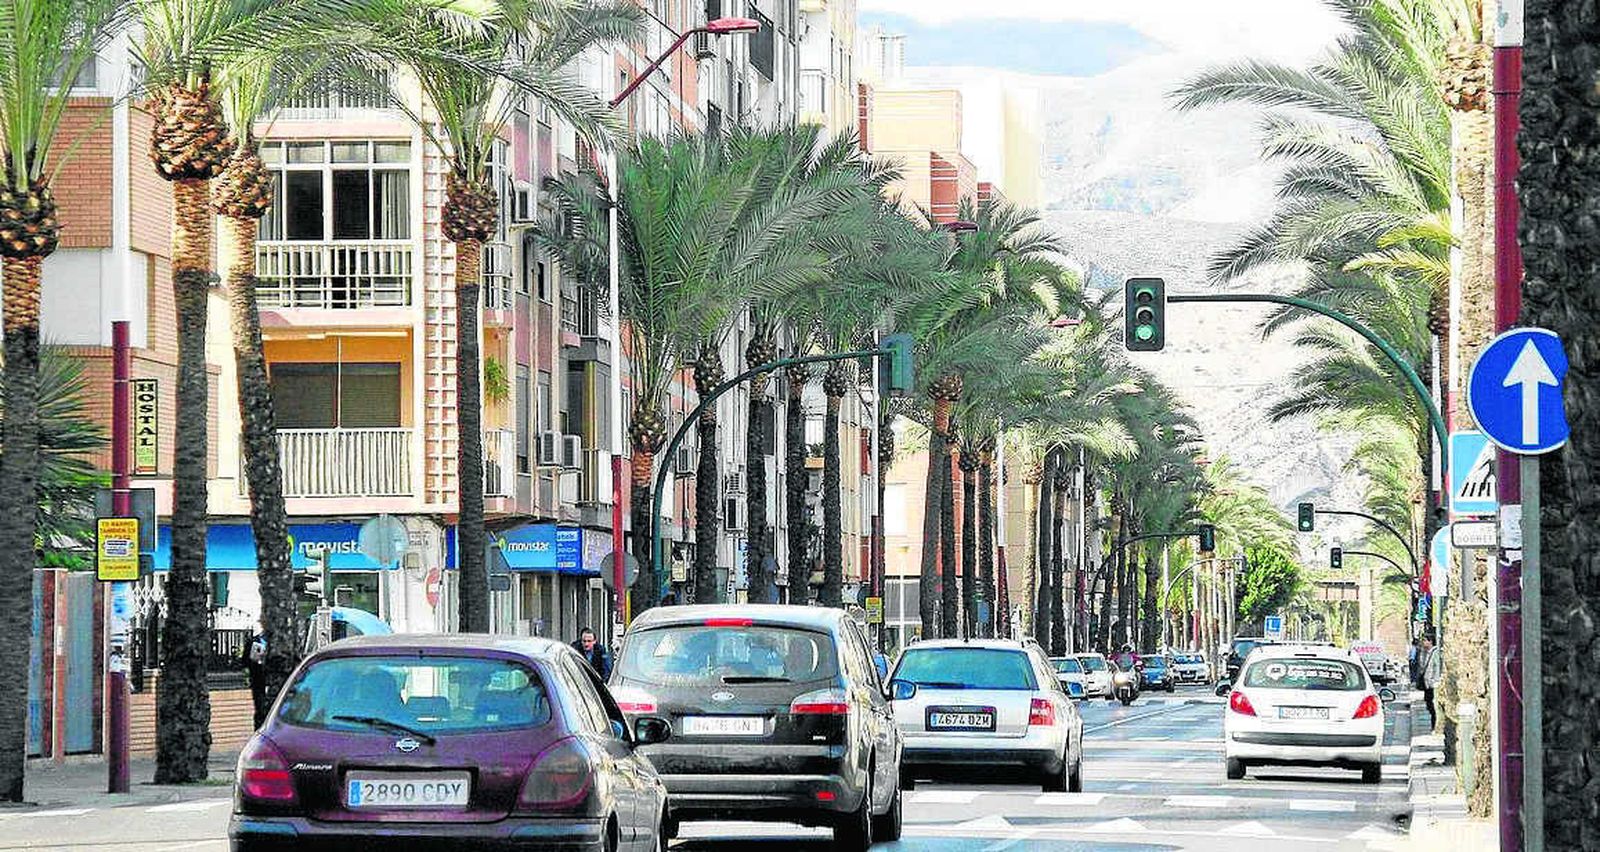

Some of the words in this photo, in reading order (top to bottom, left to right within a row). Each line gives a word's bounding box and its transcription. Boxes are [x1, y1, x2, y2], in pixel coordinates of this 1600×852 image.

[137, 383, 155, 446] HOSTAL
[299, 540, 364, 553] movist
[508, 541, 551, 552] movistar
[938, 714, 965, 726] 4674
[364, 783, 415, 801] 2890
[423, 783, 461, 801] CDY
